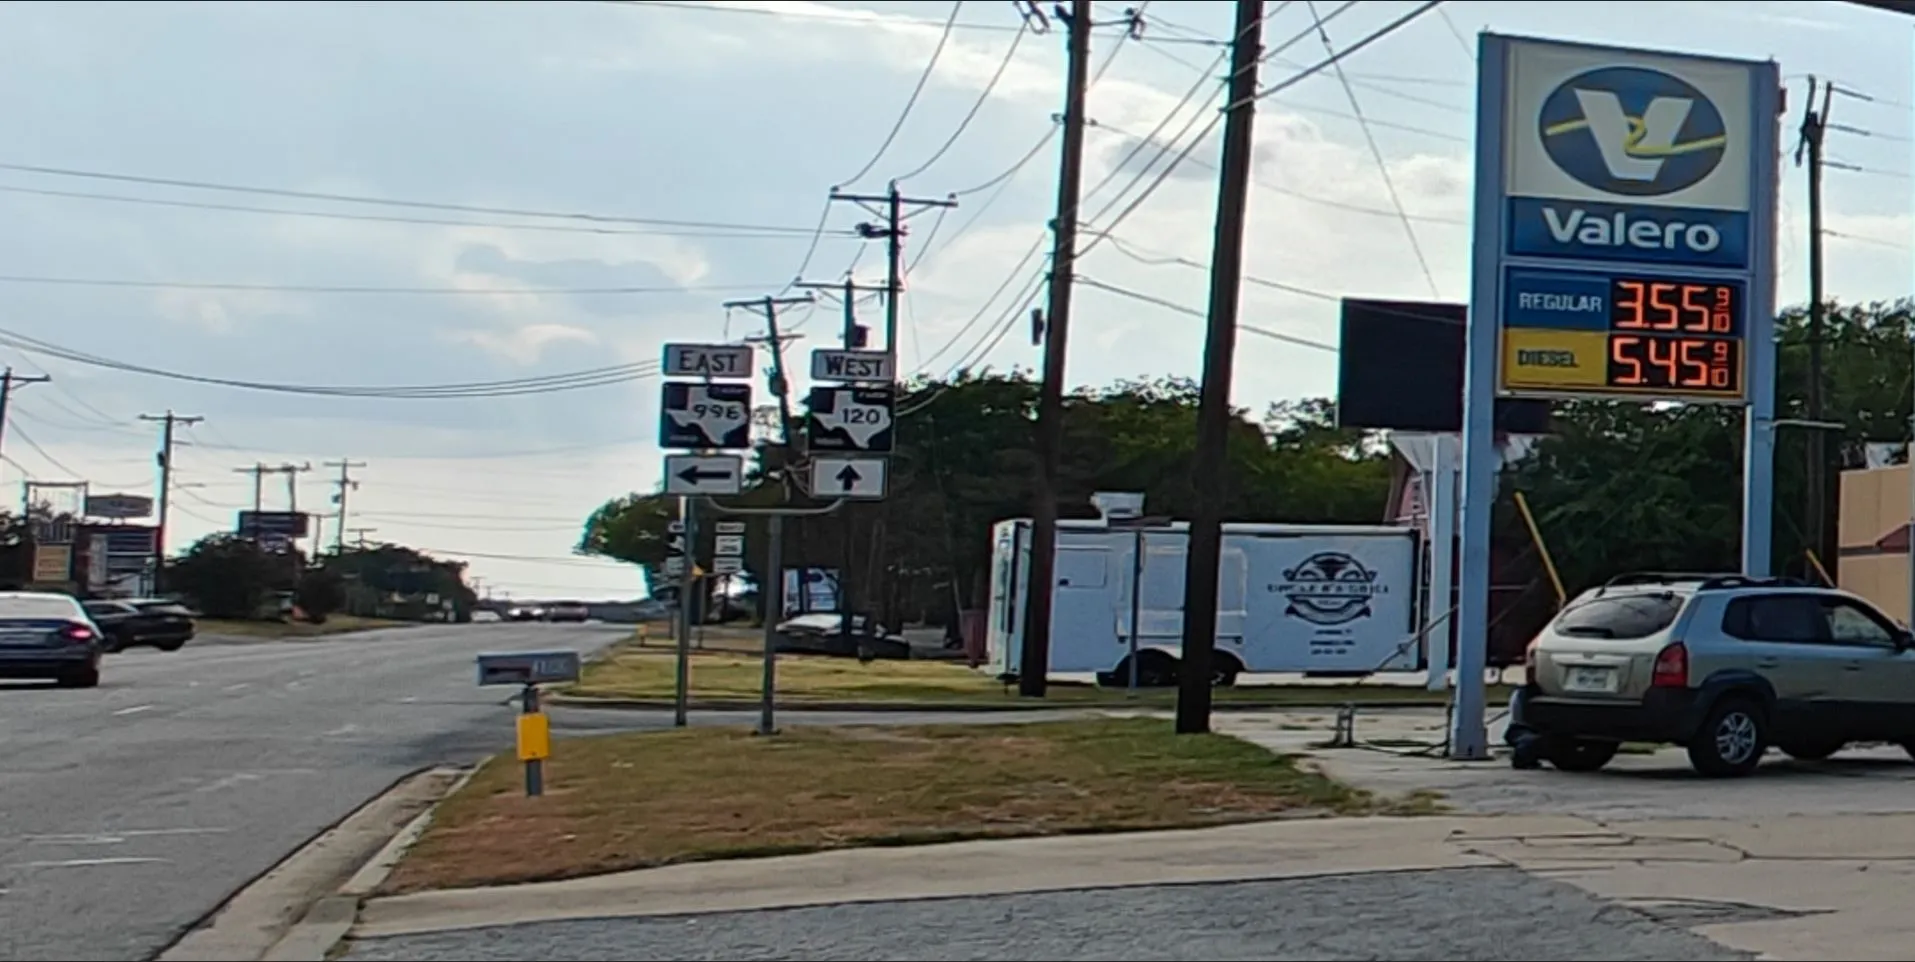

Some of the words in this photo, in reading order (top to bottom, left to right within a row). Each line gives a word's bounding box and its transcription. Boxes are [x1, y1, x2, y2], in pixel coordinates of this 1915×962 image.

[1543, 208, 1720, 252] Valero
[1519, 292, 1602, 313] REGULAR
[1616, 281, 1709, 331] 3.55
[679, 350, 738, 372] EAST
[825, 355, 884, 377] WEST
[1518, 350, 1580, 368] DIESEL
[1614, 338, 1707, 386] 5.45
[842, 408, 881, 425] 120
